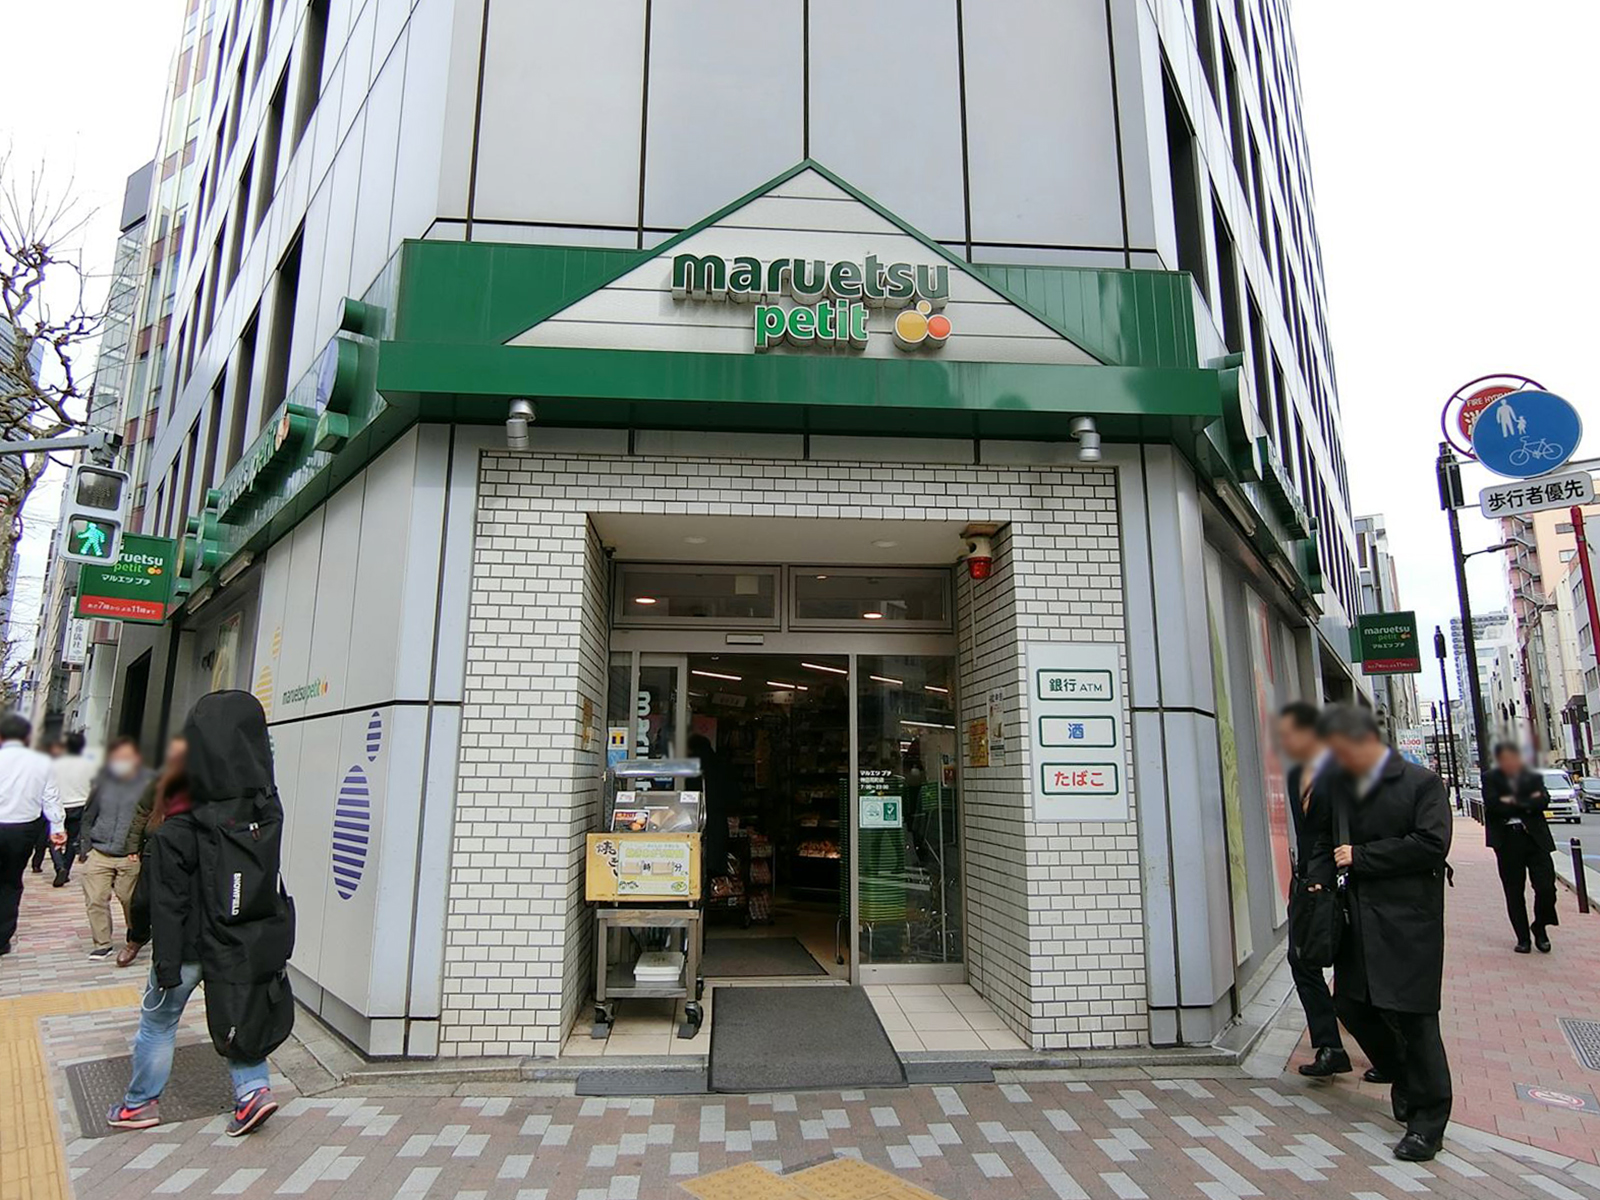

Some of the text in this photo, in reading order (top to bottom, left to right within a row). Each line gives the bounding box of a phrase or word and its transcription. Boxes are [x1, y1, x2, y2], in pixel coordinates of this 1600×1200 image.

[672, 253, 949, 301] maruetsu
[755, 300, 869, 350] petit
[1466, 398, 1483, 407] FIRE
[1488, 479, 1585, 512] 歩行者優先
[118, 552, 163, 566] ruetsu
[114, 563, 142, 573] petit
[1364, 625, 1410, 635] maruetsu
[1049, 678, 1103, 692] 銀行 ATM
[1068, 723, 1084, 739] 酒
[1054, 771, 1104, 786] たばこ
